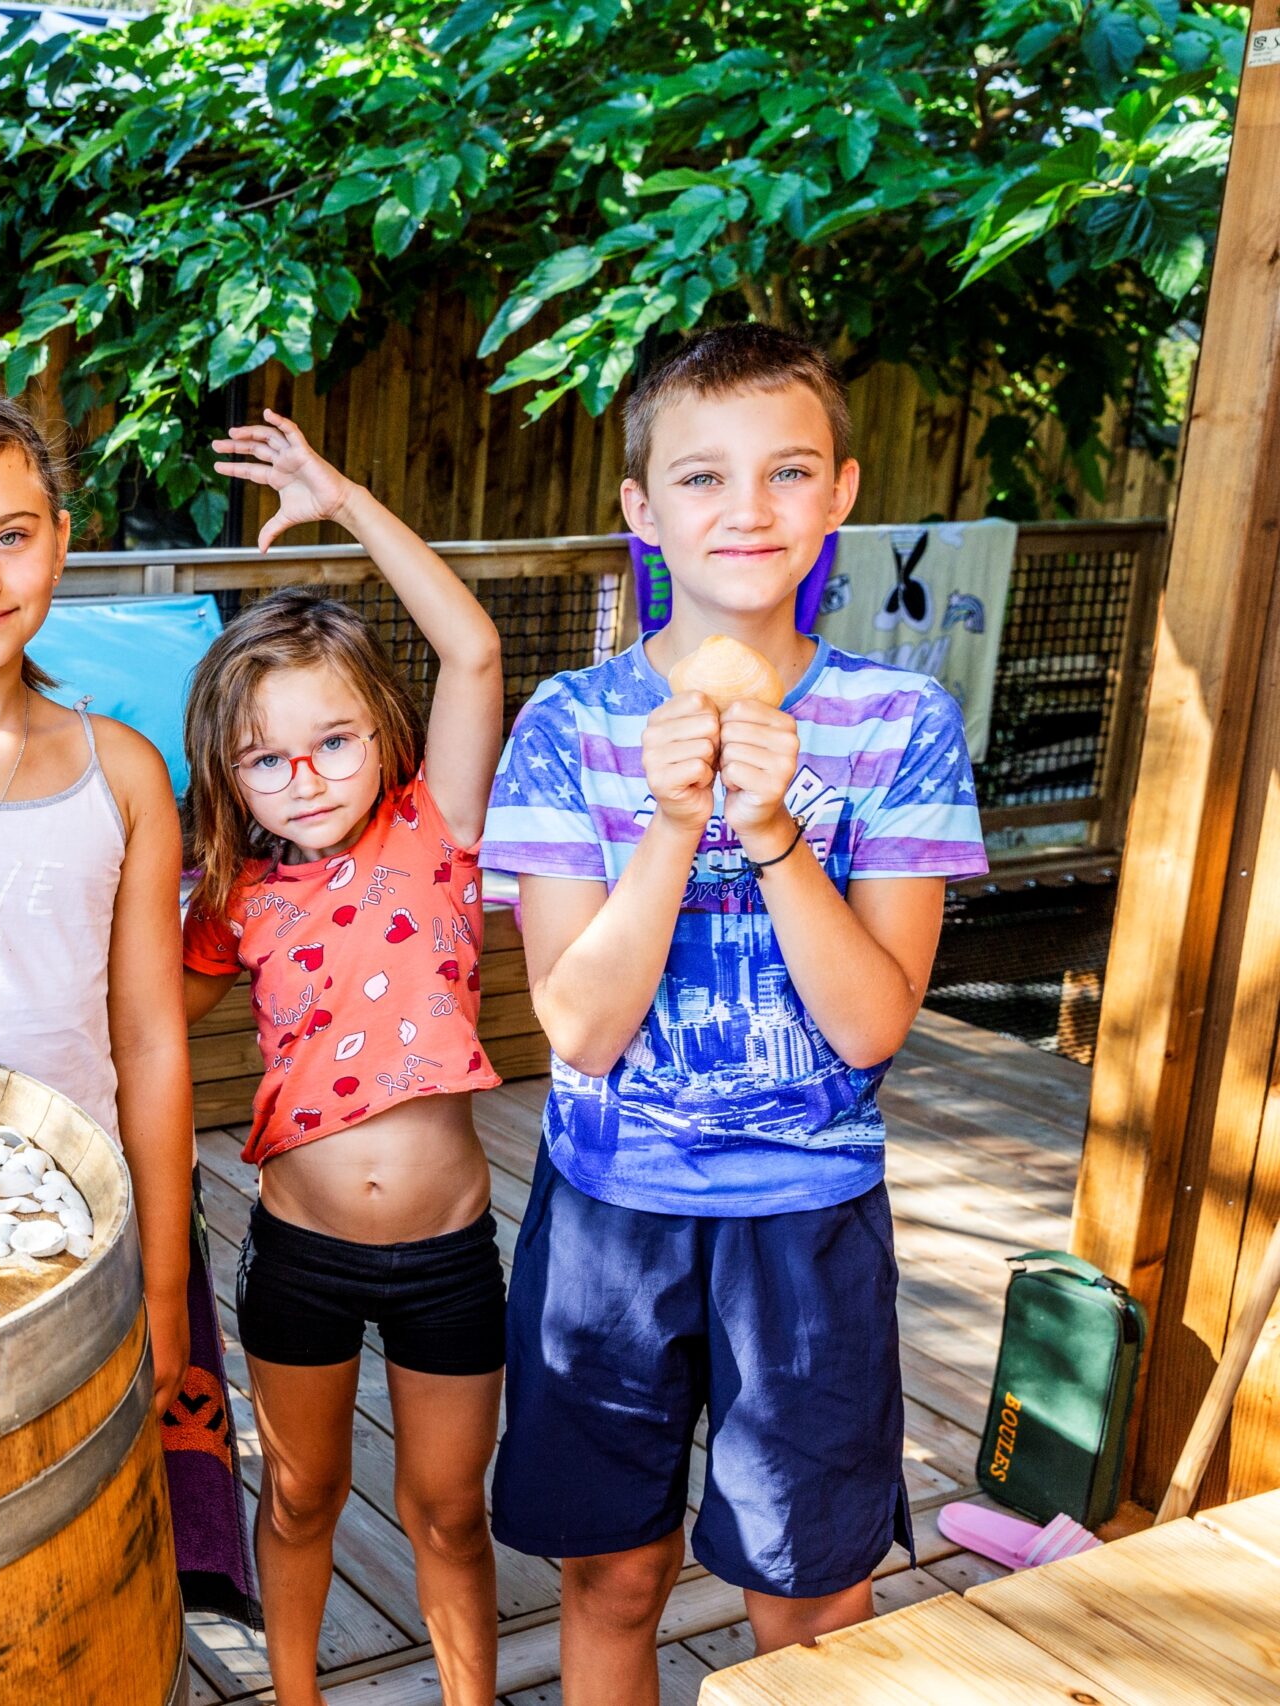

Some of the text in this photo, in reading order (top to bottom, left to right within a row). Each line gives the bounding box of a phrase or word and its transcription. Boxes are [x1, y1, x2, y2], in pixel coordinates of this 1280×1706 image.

[784, 764, 848, 833] RK
[707, 845, 748, 874] CIT
[681, 865, 765, 905] Brook
[375, 1053, 443, 1096] big
[989, 1391, 1022, 1483] BOULES
